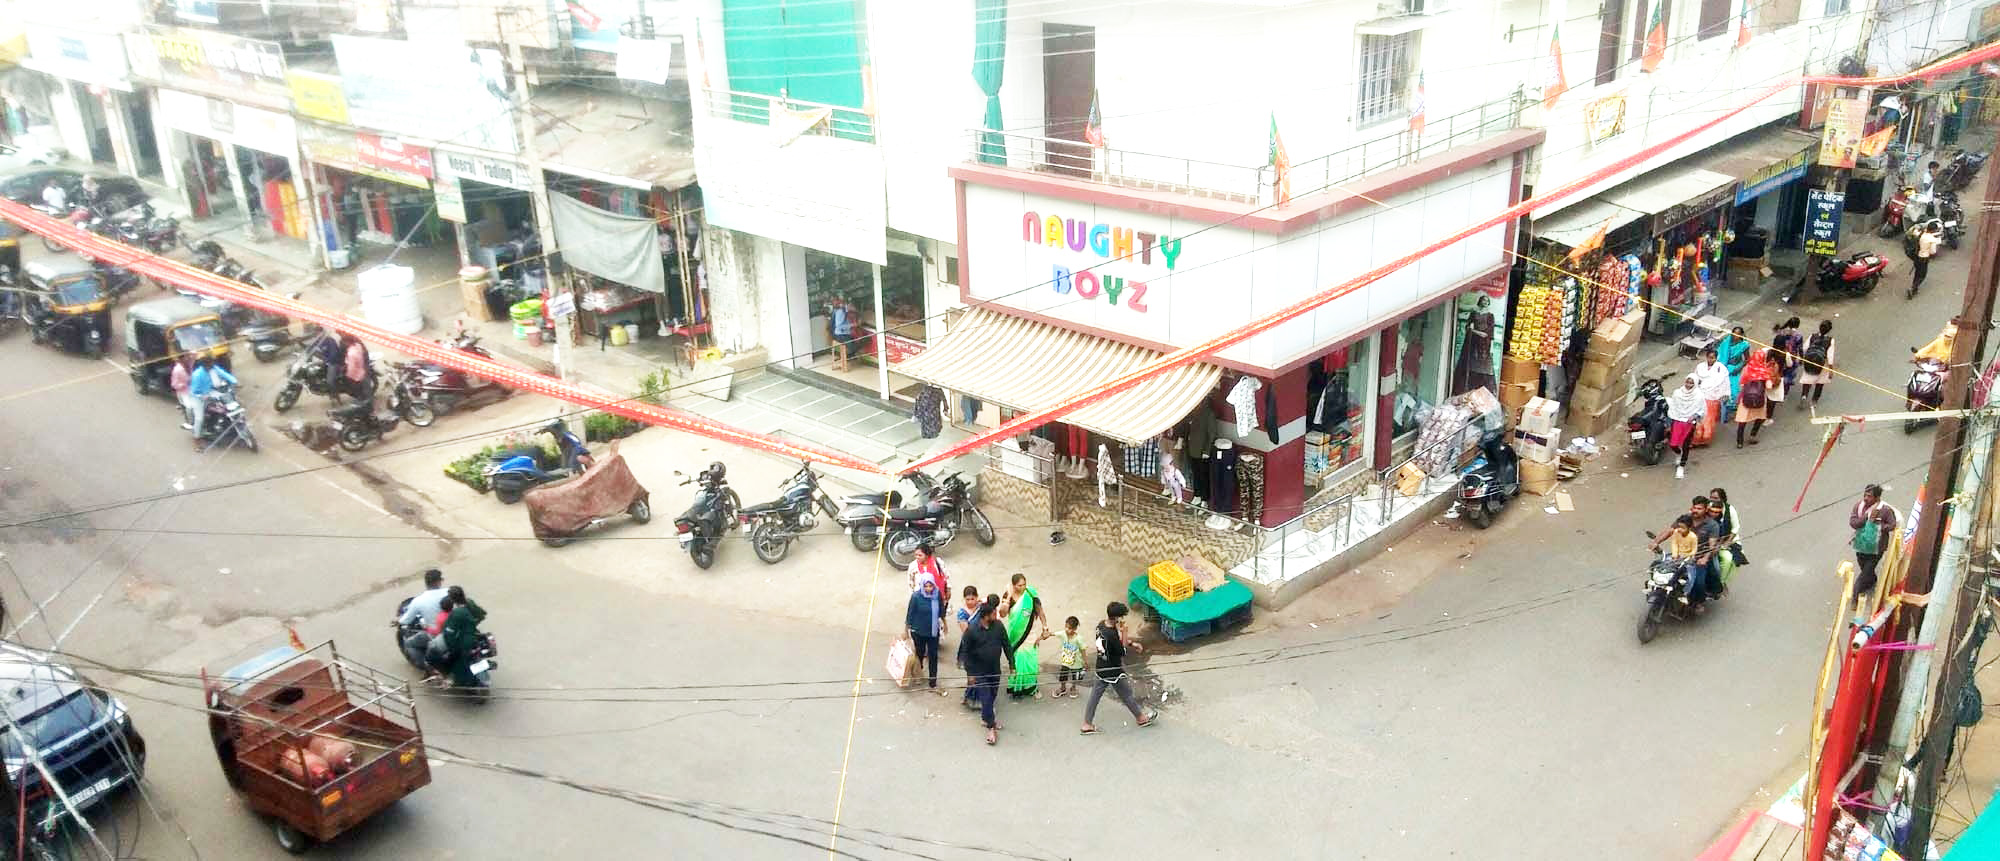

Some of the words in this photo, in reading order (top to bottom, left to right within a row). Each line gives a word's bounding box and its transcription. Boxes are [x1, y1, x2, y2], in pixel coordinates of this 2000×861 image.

[1818, 202, 1835, 211] स्कूल
[1023, 211, 1182, 270] NAUGHTY
[1053, 264, 1147, 313] BOYZ
